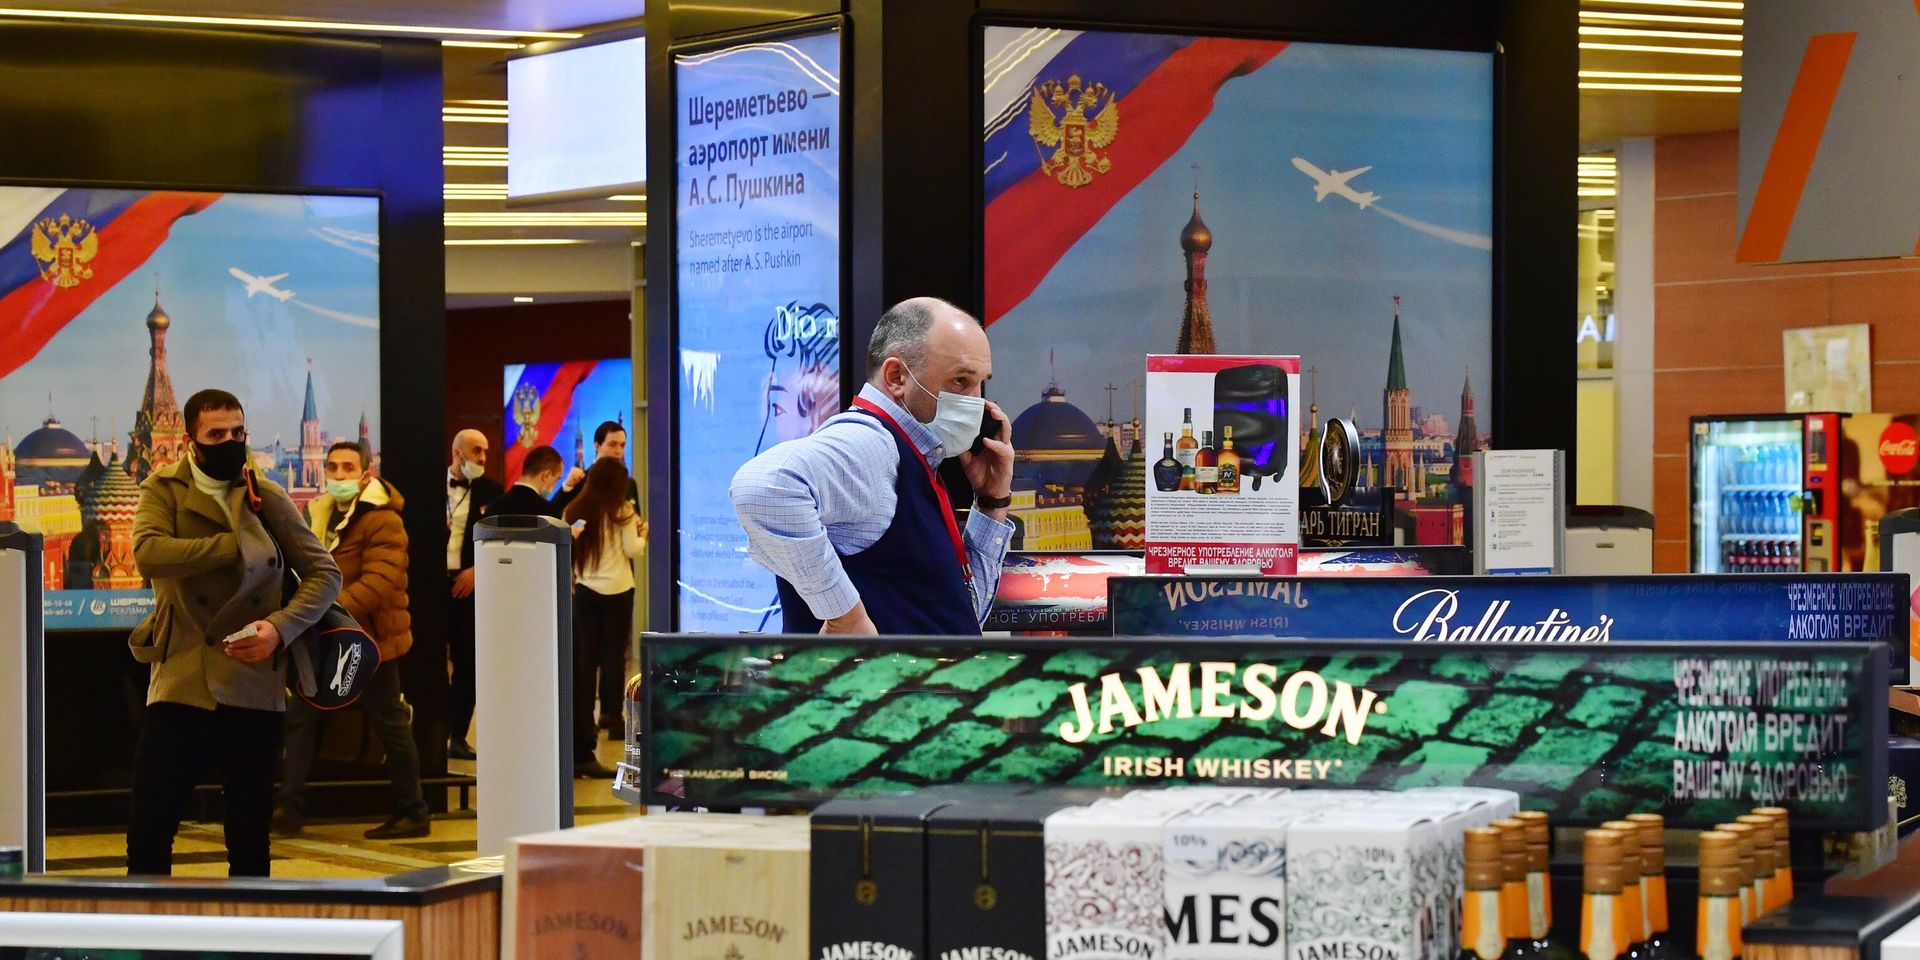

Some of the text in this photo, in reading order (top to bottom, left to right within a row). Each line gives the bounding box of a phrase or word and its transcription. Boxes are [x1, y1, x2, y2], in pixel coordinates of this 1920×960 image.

[689, 88, 808, 130] Шереметьево
[689, 126, 830, 171] аэропорт имени
[726, 171, 805, 209] Пушкина
[689, 220, 813, 250] Sheremetyevo is the airport
[689, 257, 720, 275] named
[722, 254, 743, 273] after
[764, 251, 801, 270] Pushkin
[1328, 511, 1380, 538] ТИГРАН
[1148, 546, 1294, 558] ЧРЕЗМЕРНОЕ УПОТРЕБЛЕНИЕ АЛКОГОЛЯ
[1788, 583, 1836, 611] ЧРЕЗМЕРНОЕ
[110, 607, 148, 616] РЕКЛАМА
[1392, 588, 1614, 642] Ballantine's
[1788, 614, 1895, 640] АЛКОГОЛЯ ВРЕДИТ
[1673, 659, 1752, 706] ЧРЕЗМЕРНОЕ
[1059, 661, 1378, 745] JAMESON
[1674, 711, 1848, 758] АЛКОГОЛЯ ВРЕДИТ
[1103, 756, 1184, 777] IRISH
[1673, 759, 1849, 806] ВАШЕМУ ЗДОРОВЬЮ
[535, 911, 629, 938] JAMESON
[682, 915, 786, 943] JAMESON
[940, 946, 1034, 960] AMESO
[1054, 933, 1155, 960] JAMESON
